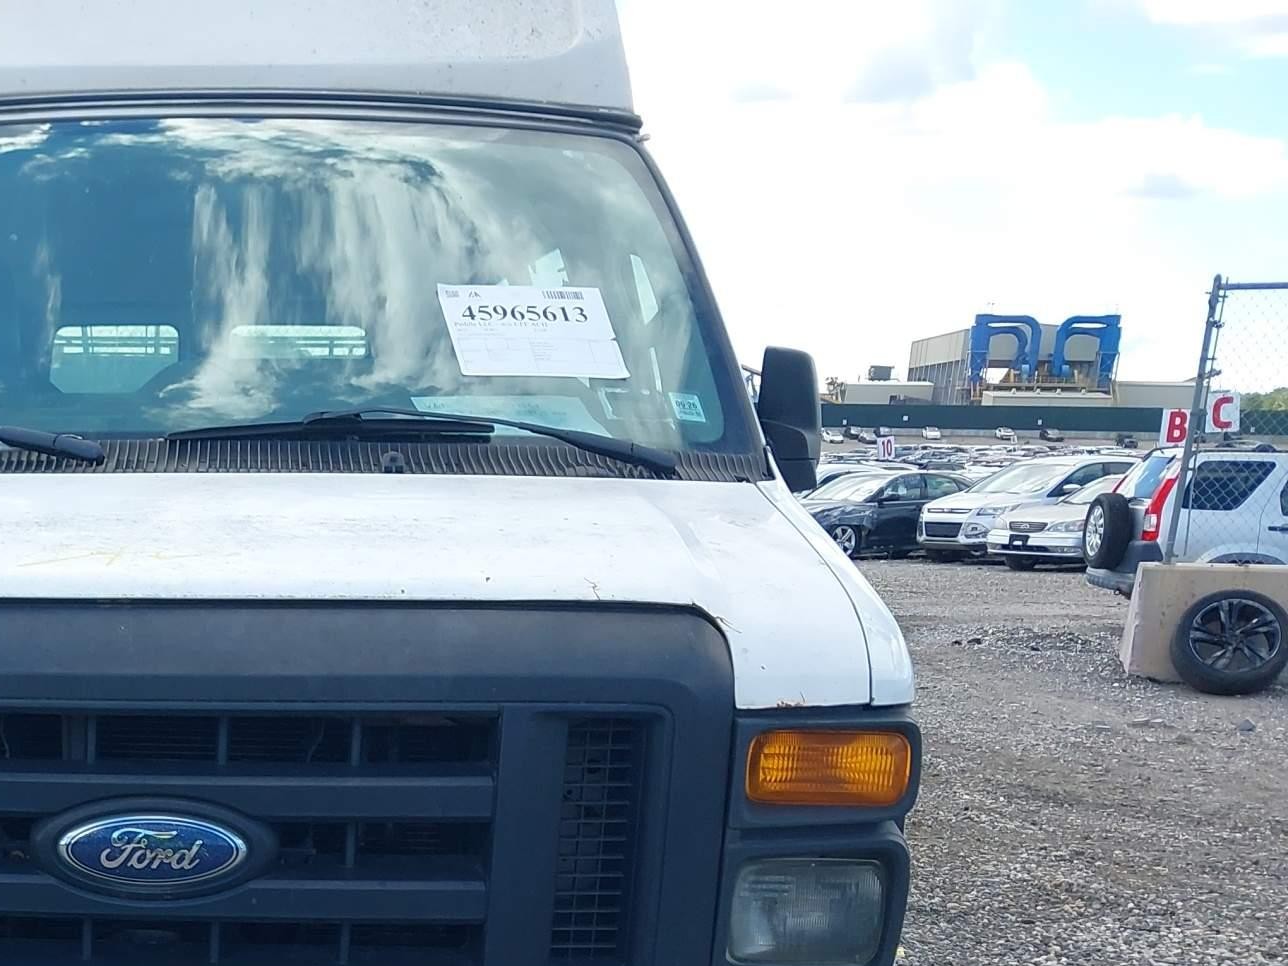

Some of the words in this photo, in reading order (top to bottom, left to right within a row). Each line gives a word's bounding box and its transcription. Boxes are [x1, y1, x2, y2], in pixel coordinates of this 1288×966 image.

[462, 304, 588, 323] 45965613
[1166, 410, 1188, 443] B
[1212, 396, 1234, 429] C
[881, 438, 893, 458] 10
[100, 827, 204, 870] Ford
